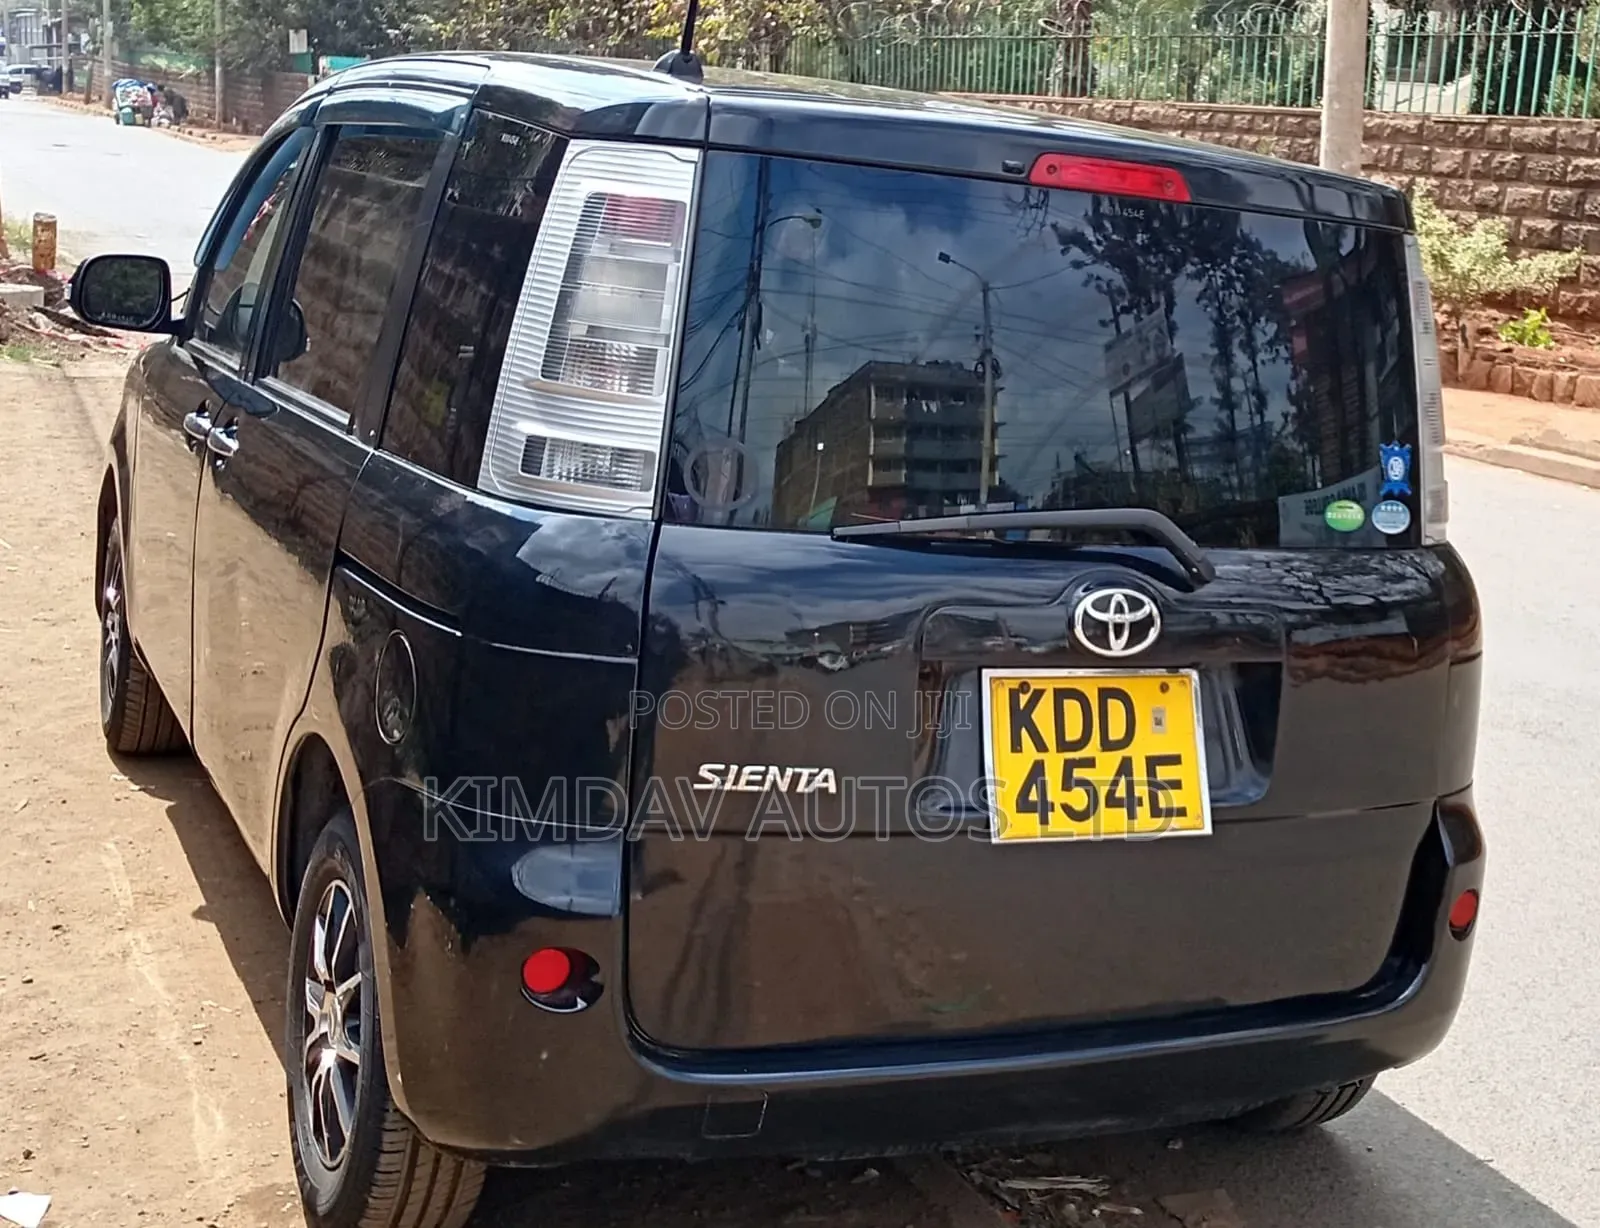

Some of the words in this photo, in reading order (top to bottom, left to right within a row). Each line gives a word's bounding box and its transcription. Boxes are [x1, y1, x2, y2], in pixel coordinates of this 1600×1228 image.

[1008, 686, 1136, 754] KDD
[693, 763, 838, 795] SIENTA
[1015, 754, 1188, 826] 454E
